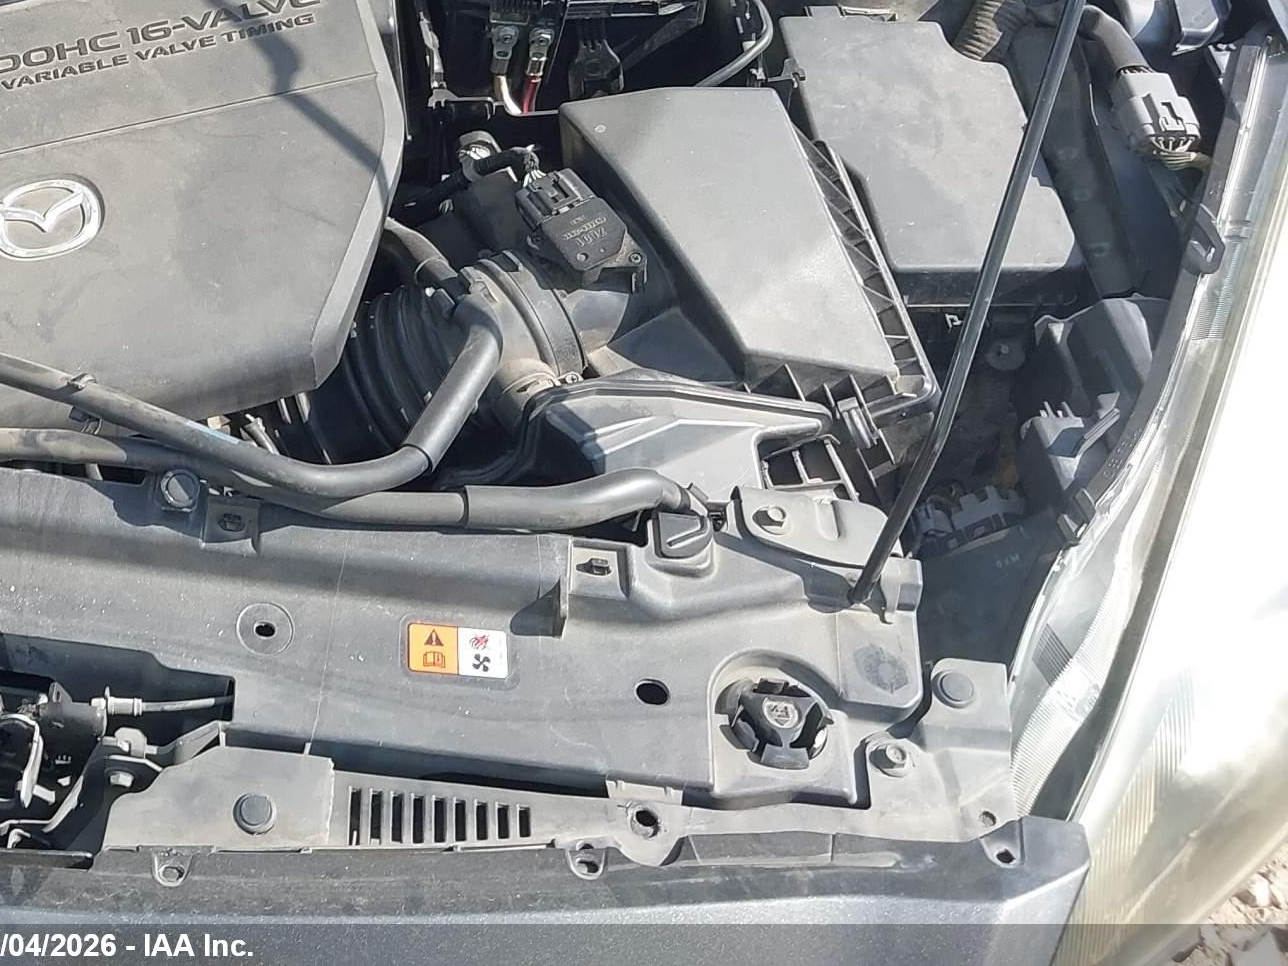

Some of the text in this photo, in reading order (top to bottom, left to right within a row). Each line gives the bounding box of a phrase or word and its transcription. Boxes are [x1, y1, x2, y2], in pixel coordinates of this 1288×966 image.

[0, 13, 315, 90] VARIABLE VALVE TIMING
